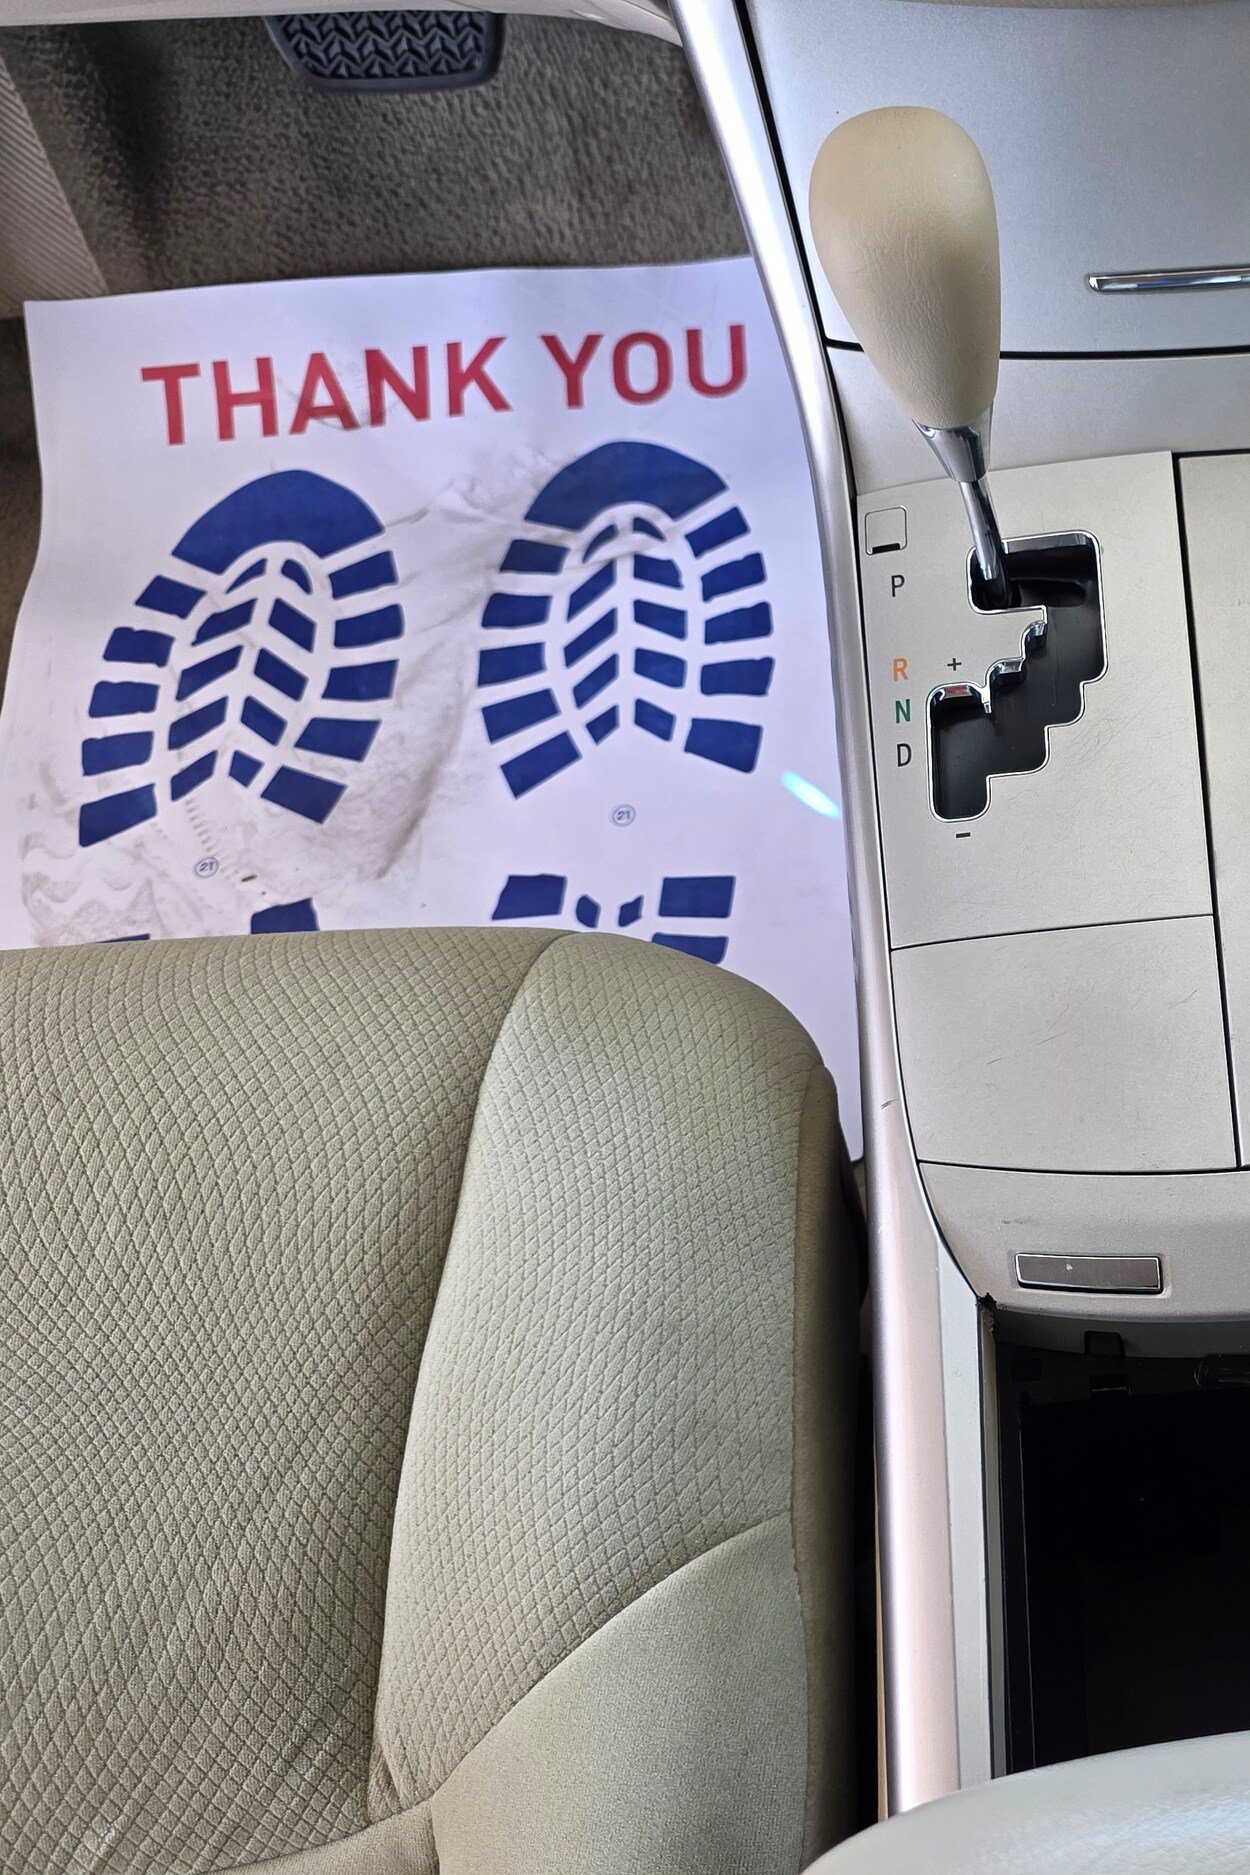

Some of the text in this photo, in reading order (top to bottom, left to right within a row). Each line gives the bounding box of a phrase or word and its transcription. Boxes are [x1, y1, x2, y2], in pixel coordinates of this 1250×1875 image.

[141, 324, 747, 446] THANK YOU
[891, 574, 905, 598] P
[892, 657, 909, 682] R
[895, 698, 912, 724] N
[896, 742, 913, 768] D
